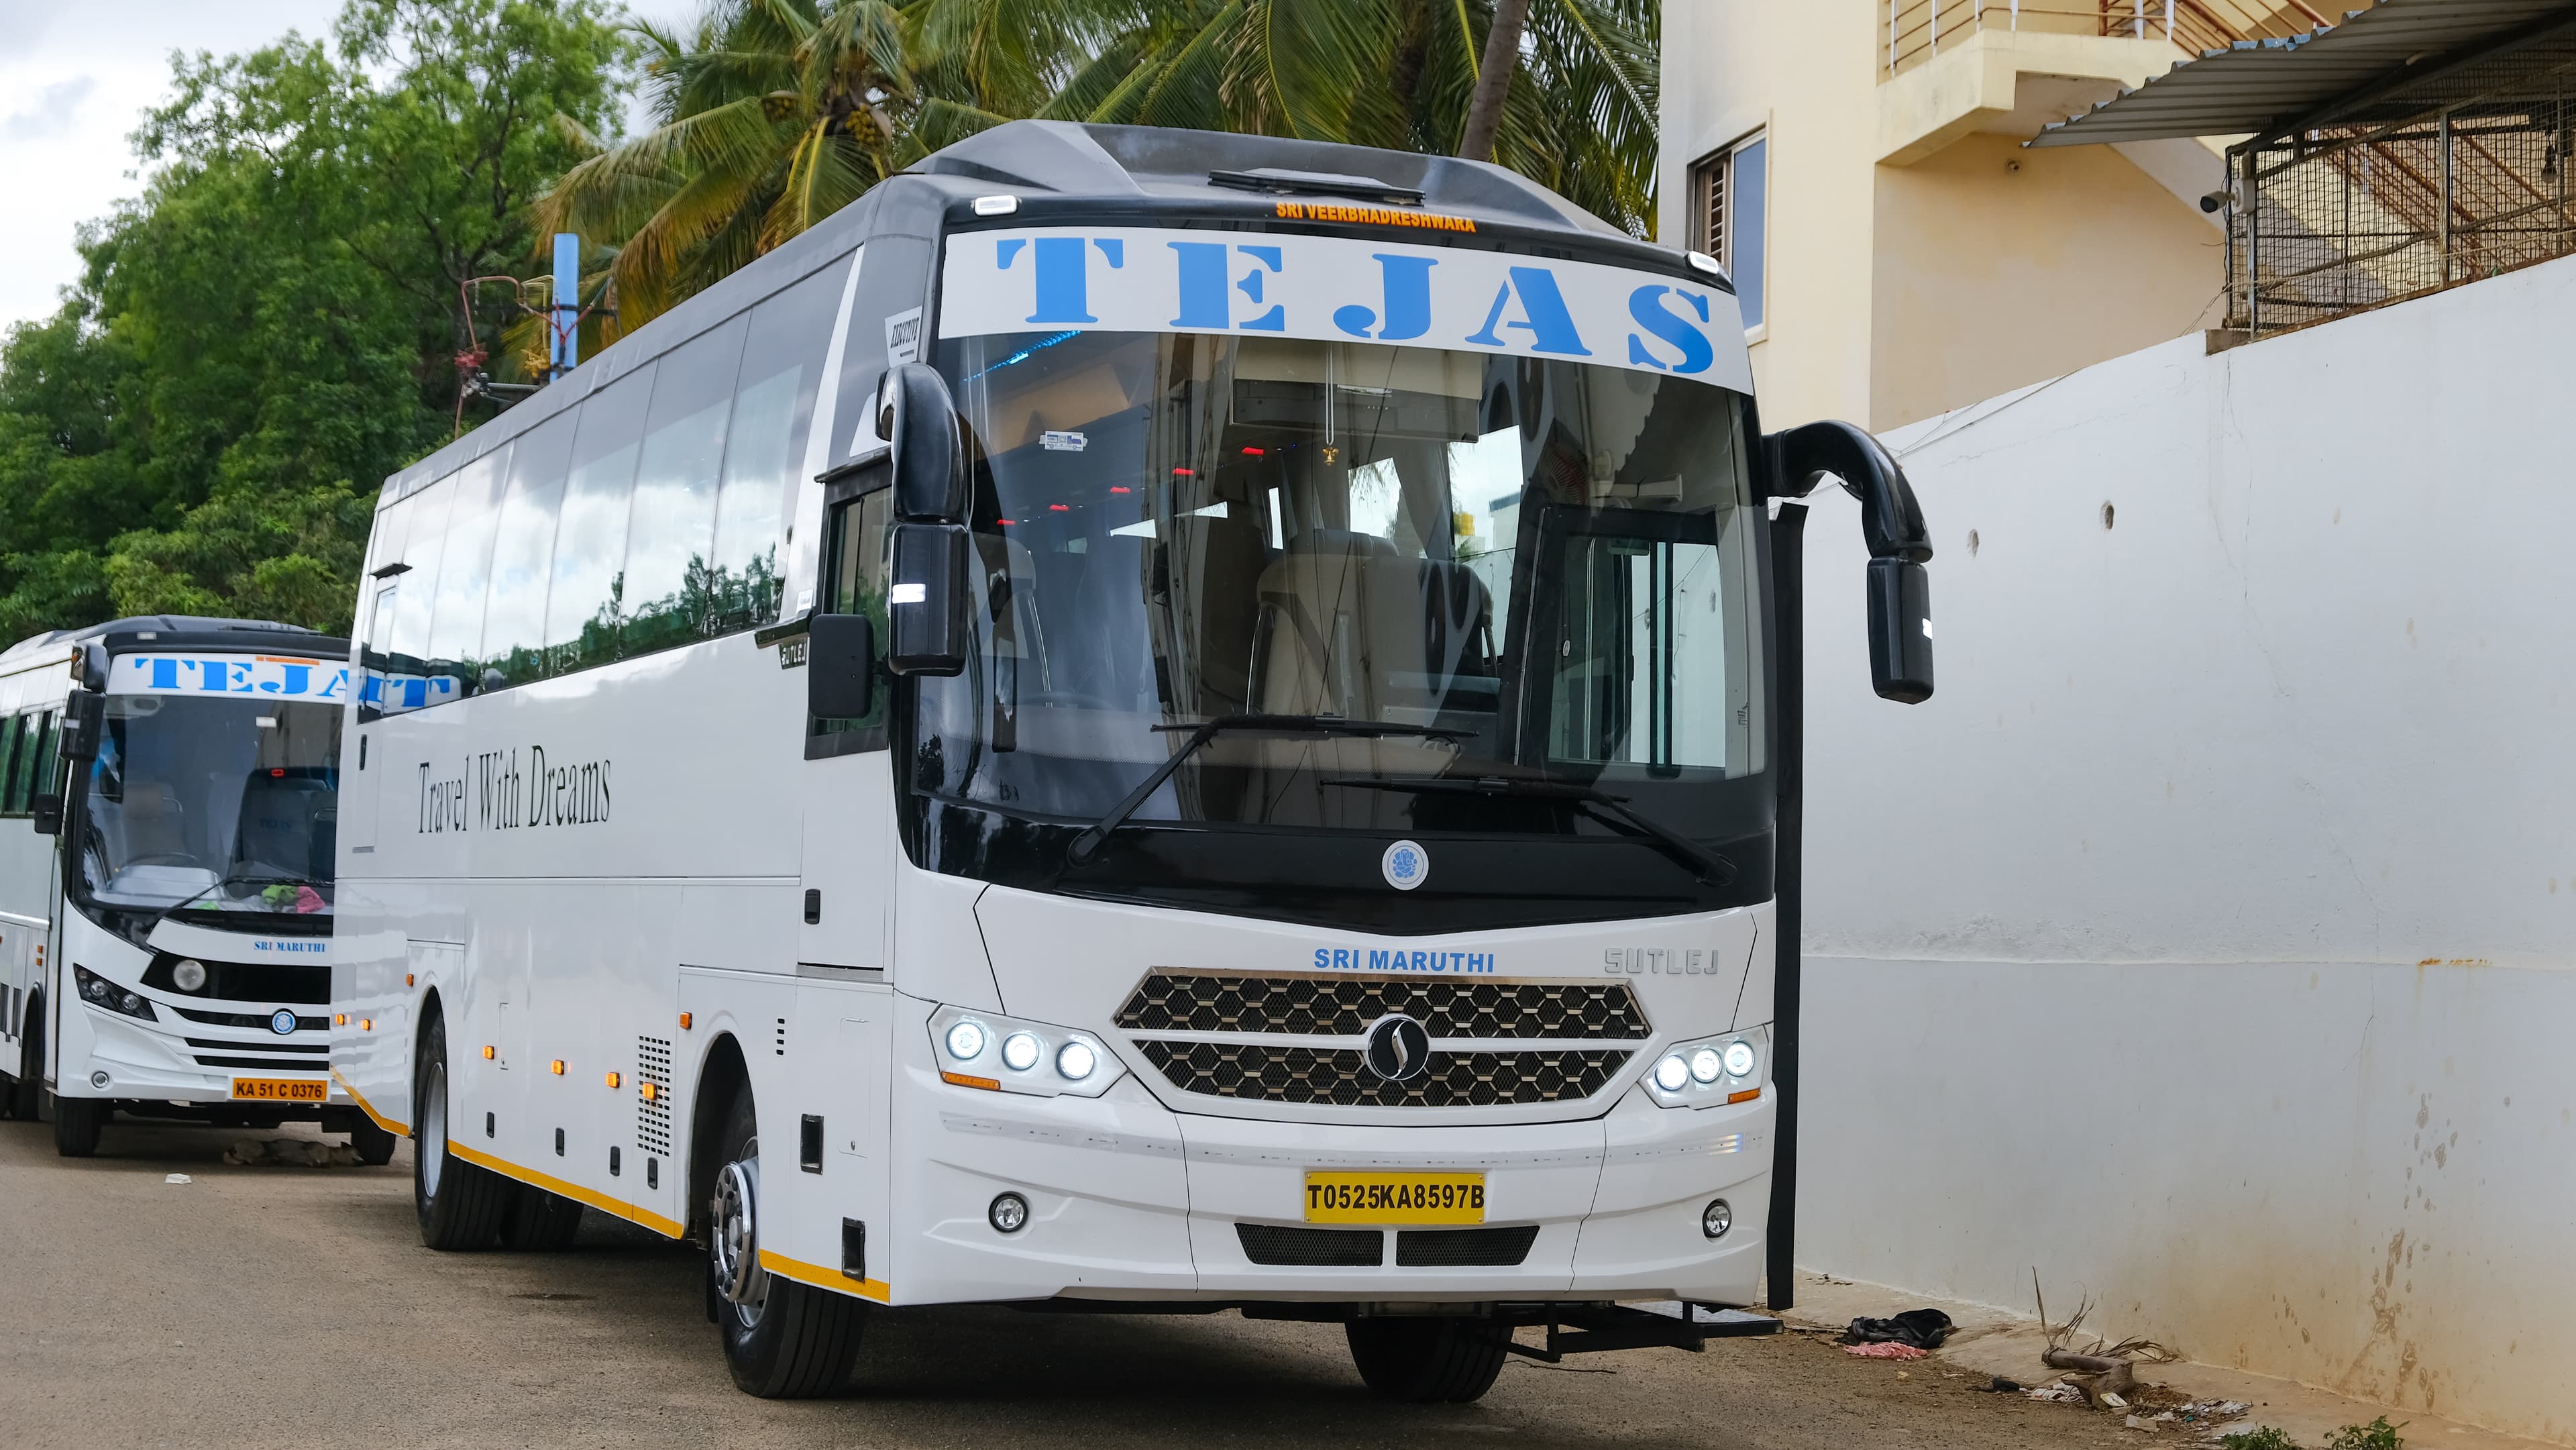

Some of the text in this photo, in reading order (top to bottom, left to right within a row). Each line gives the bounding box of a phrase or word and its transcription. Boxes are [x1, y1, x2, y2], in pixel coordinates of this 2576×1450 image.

[1277, 203, 1477, 233] SRI VEERBHADRESHWARA
[997, 238, 1713, 374] TEJAS
[890, 316, 919, 348] EXECUTIVE
[419, 745, 611, 833] Travel With Dreams
[254, 941, 325, 953] SRI MARUTHI
[1314, 948, 1494, 973] SRI MARUTHI
[1605, 948, 1719, 974] SUTLEJ
[236, 1082, 323, 1098] KA 51 C 0376
[1307, 1184, 1485, 1209] T0525KA8597B
